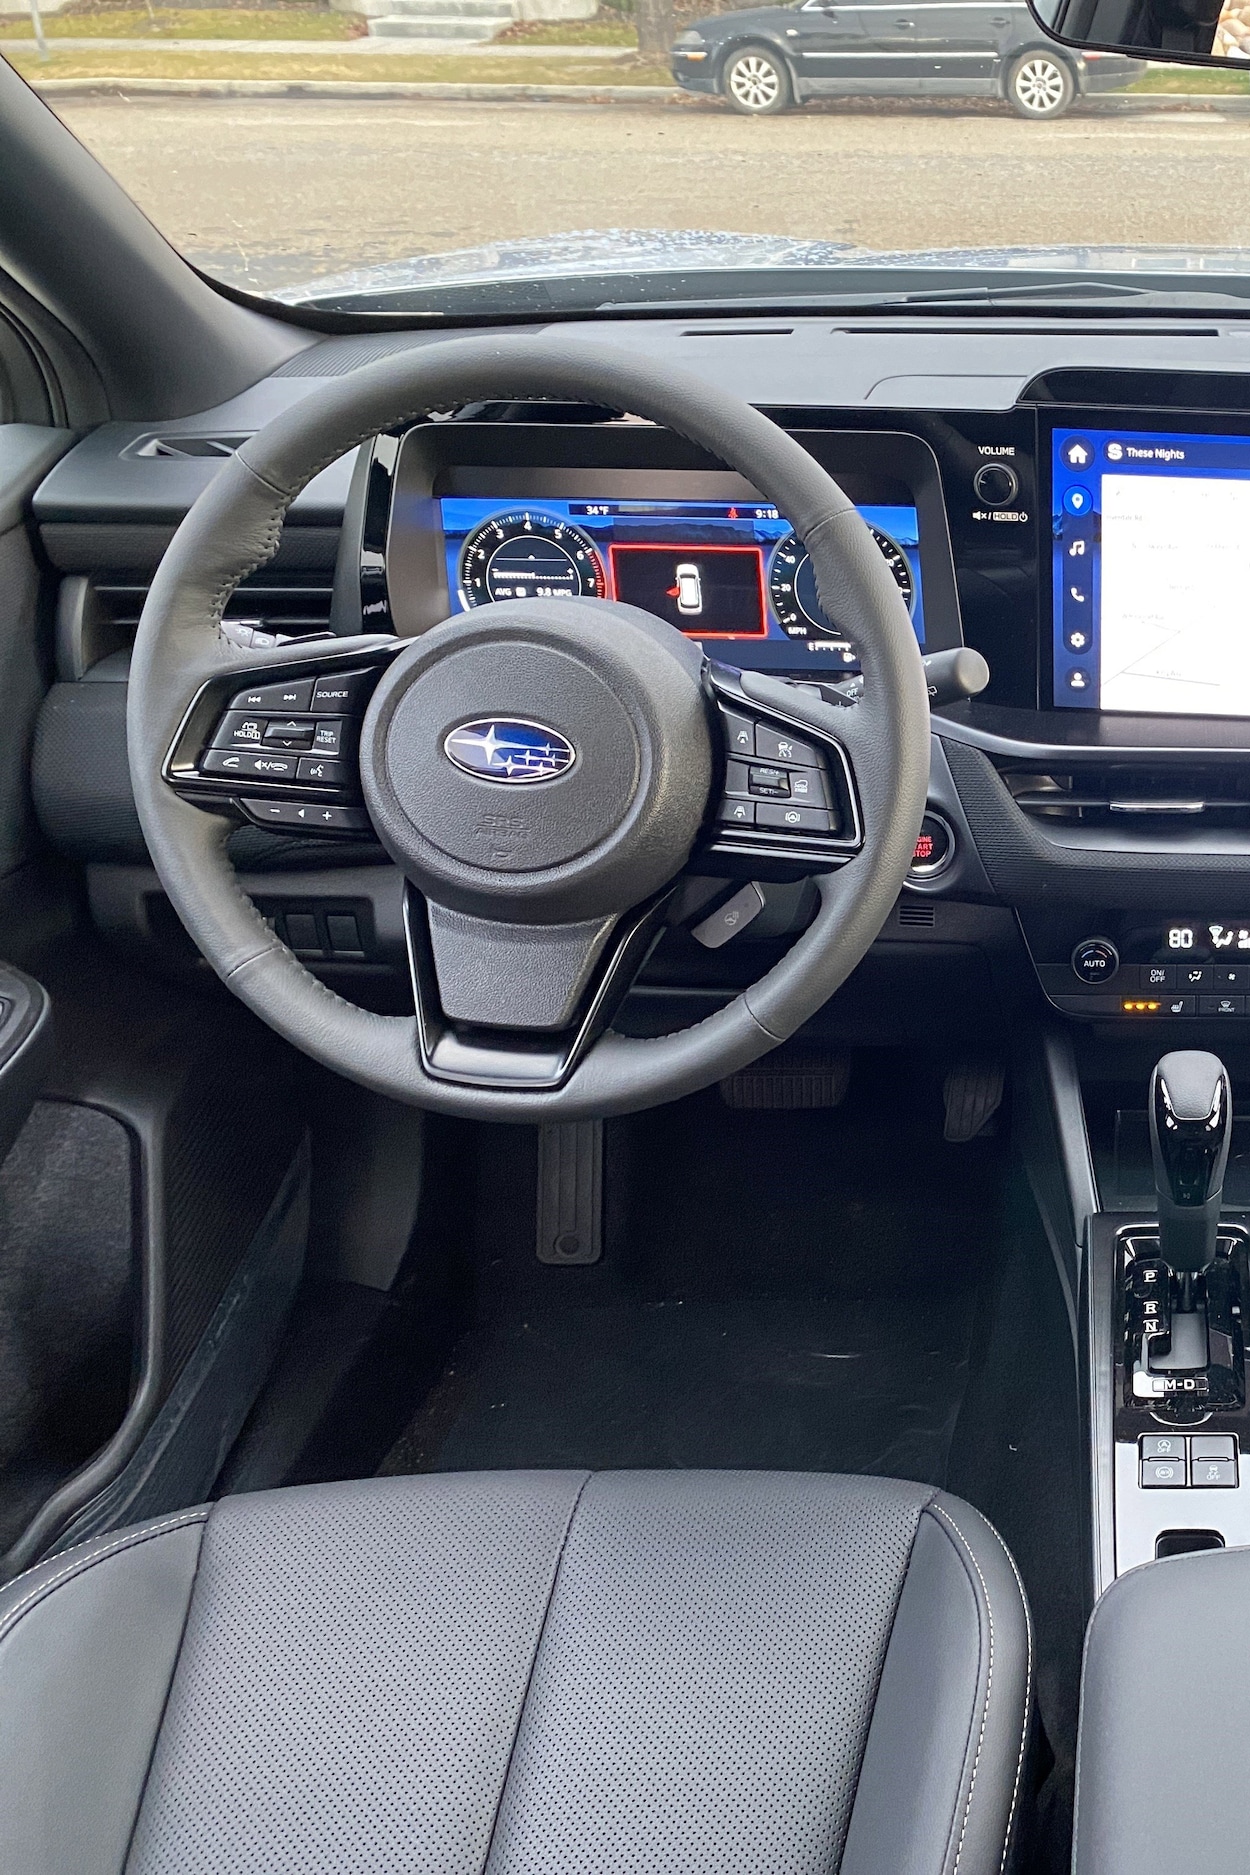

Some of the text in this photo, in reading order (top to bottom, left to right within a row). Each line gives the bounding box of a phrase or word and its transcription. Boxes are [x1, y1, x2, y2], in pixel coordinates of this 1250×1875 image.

[978, 446, 1015, 456] VOLUME
[1126, 447, 1186, 462] These Nights
[755, 509, 779, 519] 9:18
[523, 521, 532, 531] 4
[496, 529, 505, 539] 3
[554, 529, 563, 540] 5
[476, 549, 486, 560] 2
[576, 550, 585, 560] 6
[784, 555, 796, 564] 40
[474, 578, 481, 588] 1
[587, 578, 595, 588] 7
[780, 583, 792, 592] 20
[495, 588, 512, 596] AVG
[536, 587, 552, 597] 9.8
[789, 612, 797, 622] 0
[788, 626, 807, 636] MPH
[808, 642, 815, 651] E
[316, 690, 349, 698] SOURCE
[320, 729, 334, 737] TRIP
[316, 735, 337, 744] RESET
[917, 835, 932, 843] GINE
[1169, 928, 1193, 948] 80
[1083, 960, 1106, 968] AUTO
[1150, 969, 1165, 977] ON/
[1145, 1272, 1155, 1283] P
[1145, 1303, 1157, 1314] R
[1145, 1321, 1158, 1332] N
